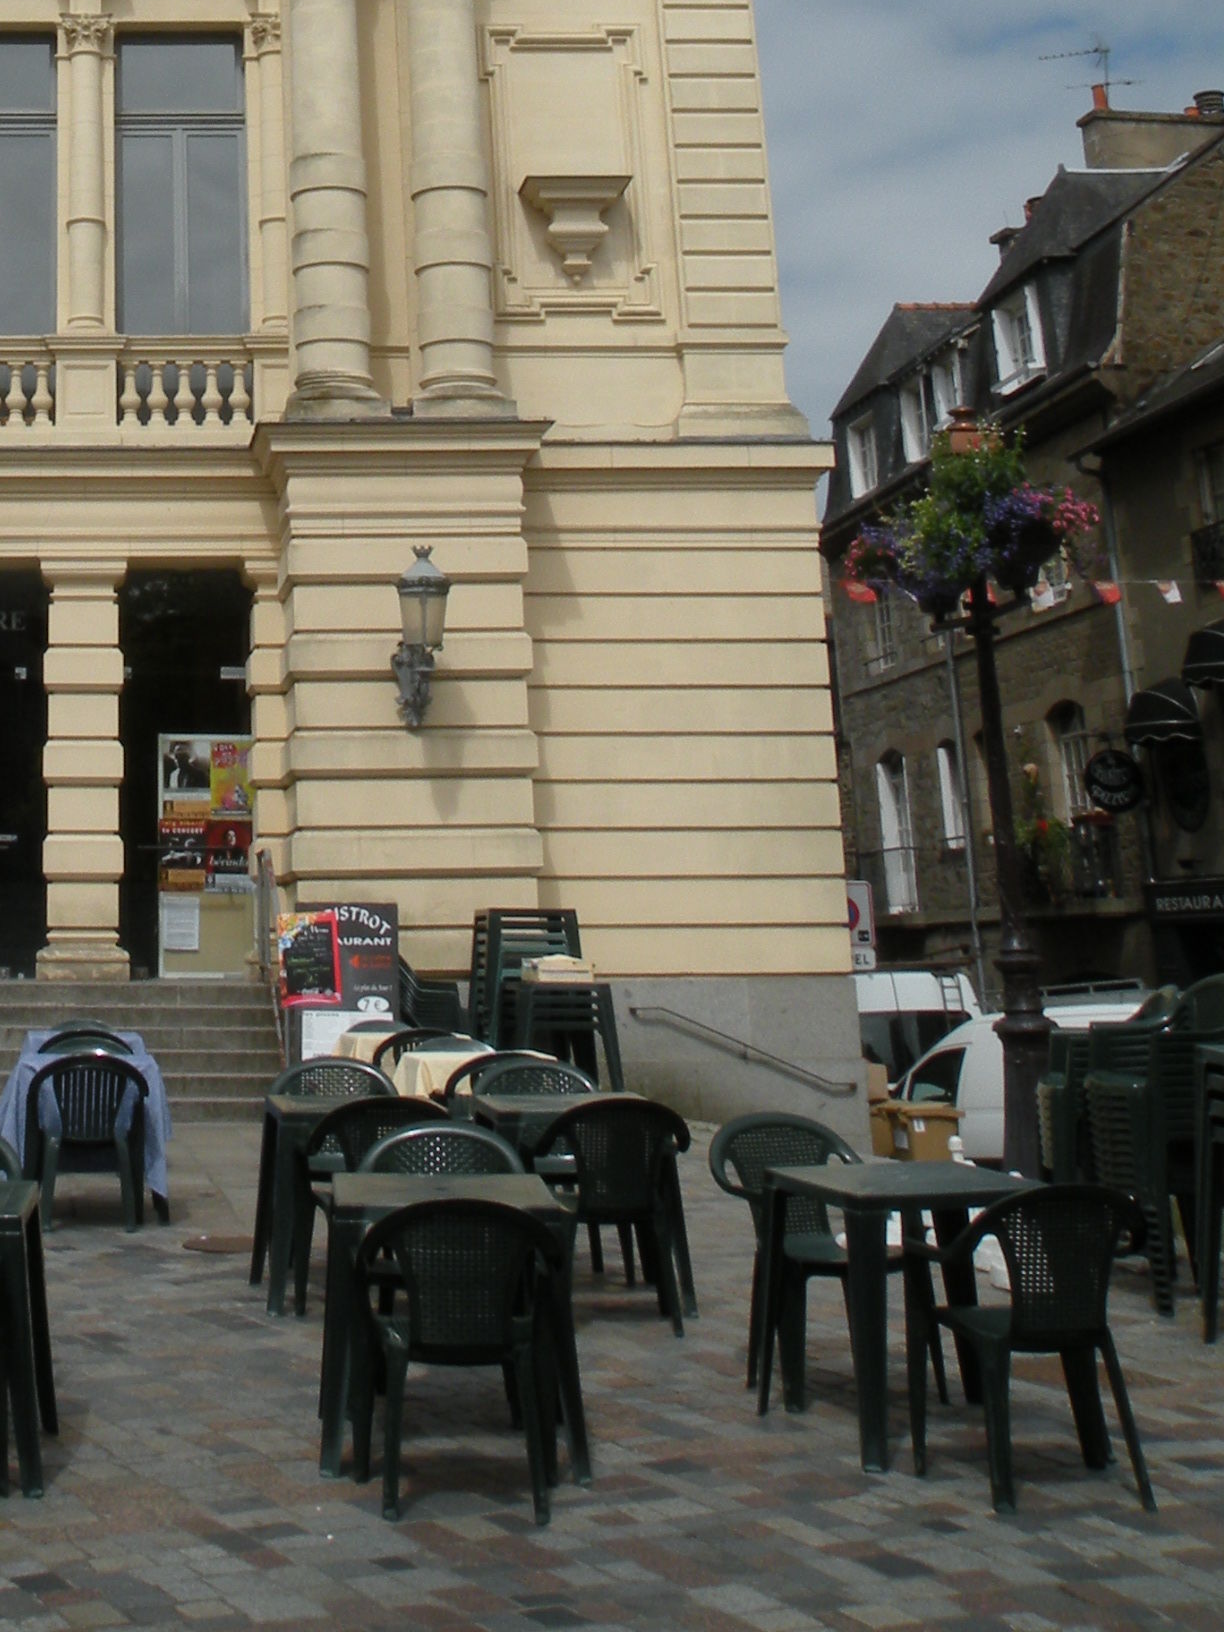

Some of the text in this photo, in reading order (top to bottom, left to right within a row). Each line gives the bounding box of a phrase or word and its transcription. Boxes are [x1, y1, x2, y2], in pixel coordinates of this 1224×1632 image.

[1156, 895, 1224, 912] RESTAURA
[324, 906, 392, 935] ISTROT
[337, 936, 392, 946] AURANT
